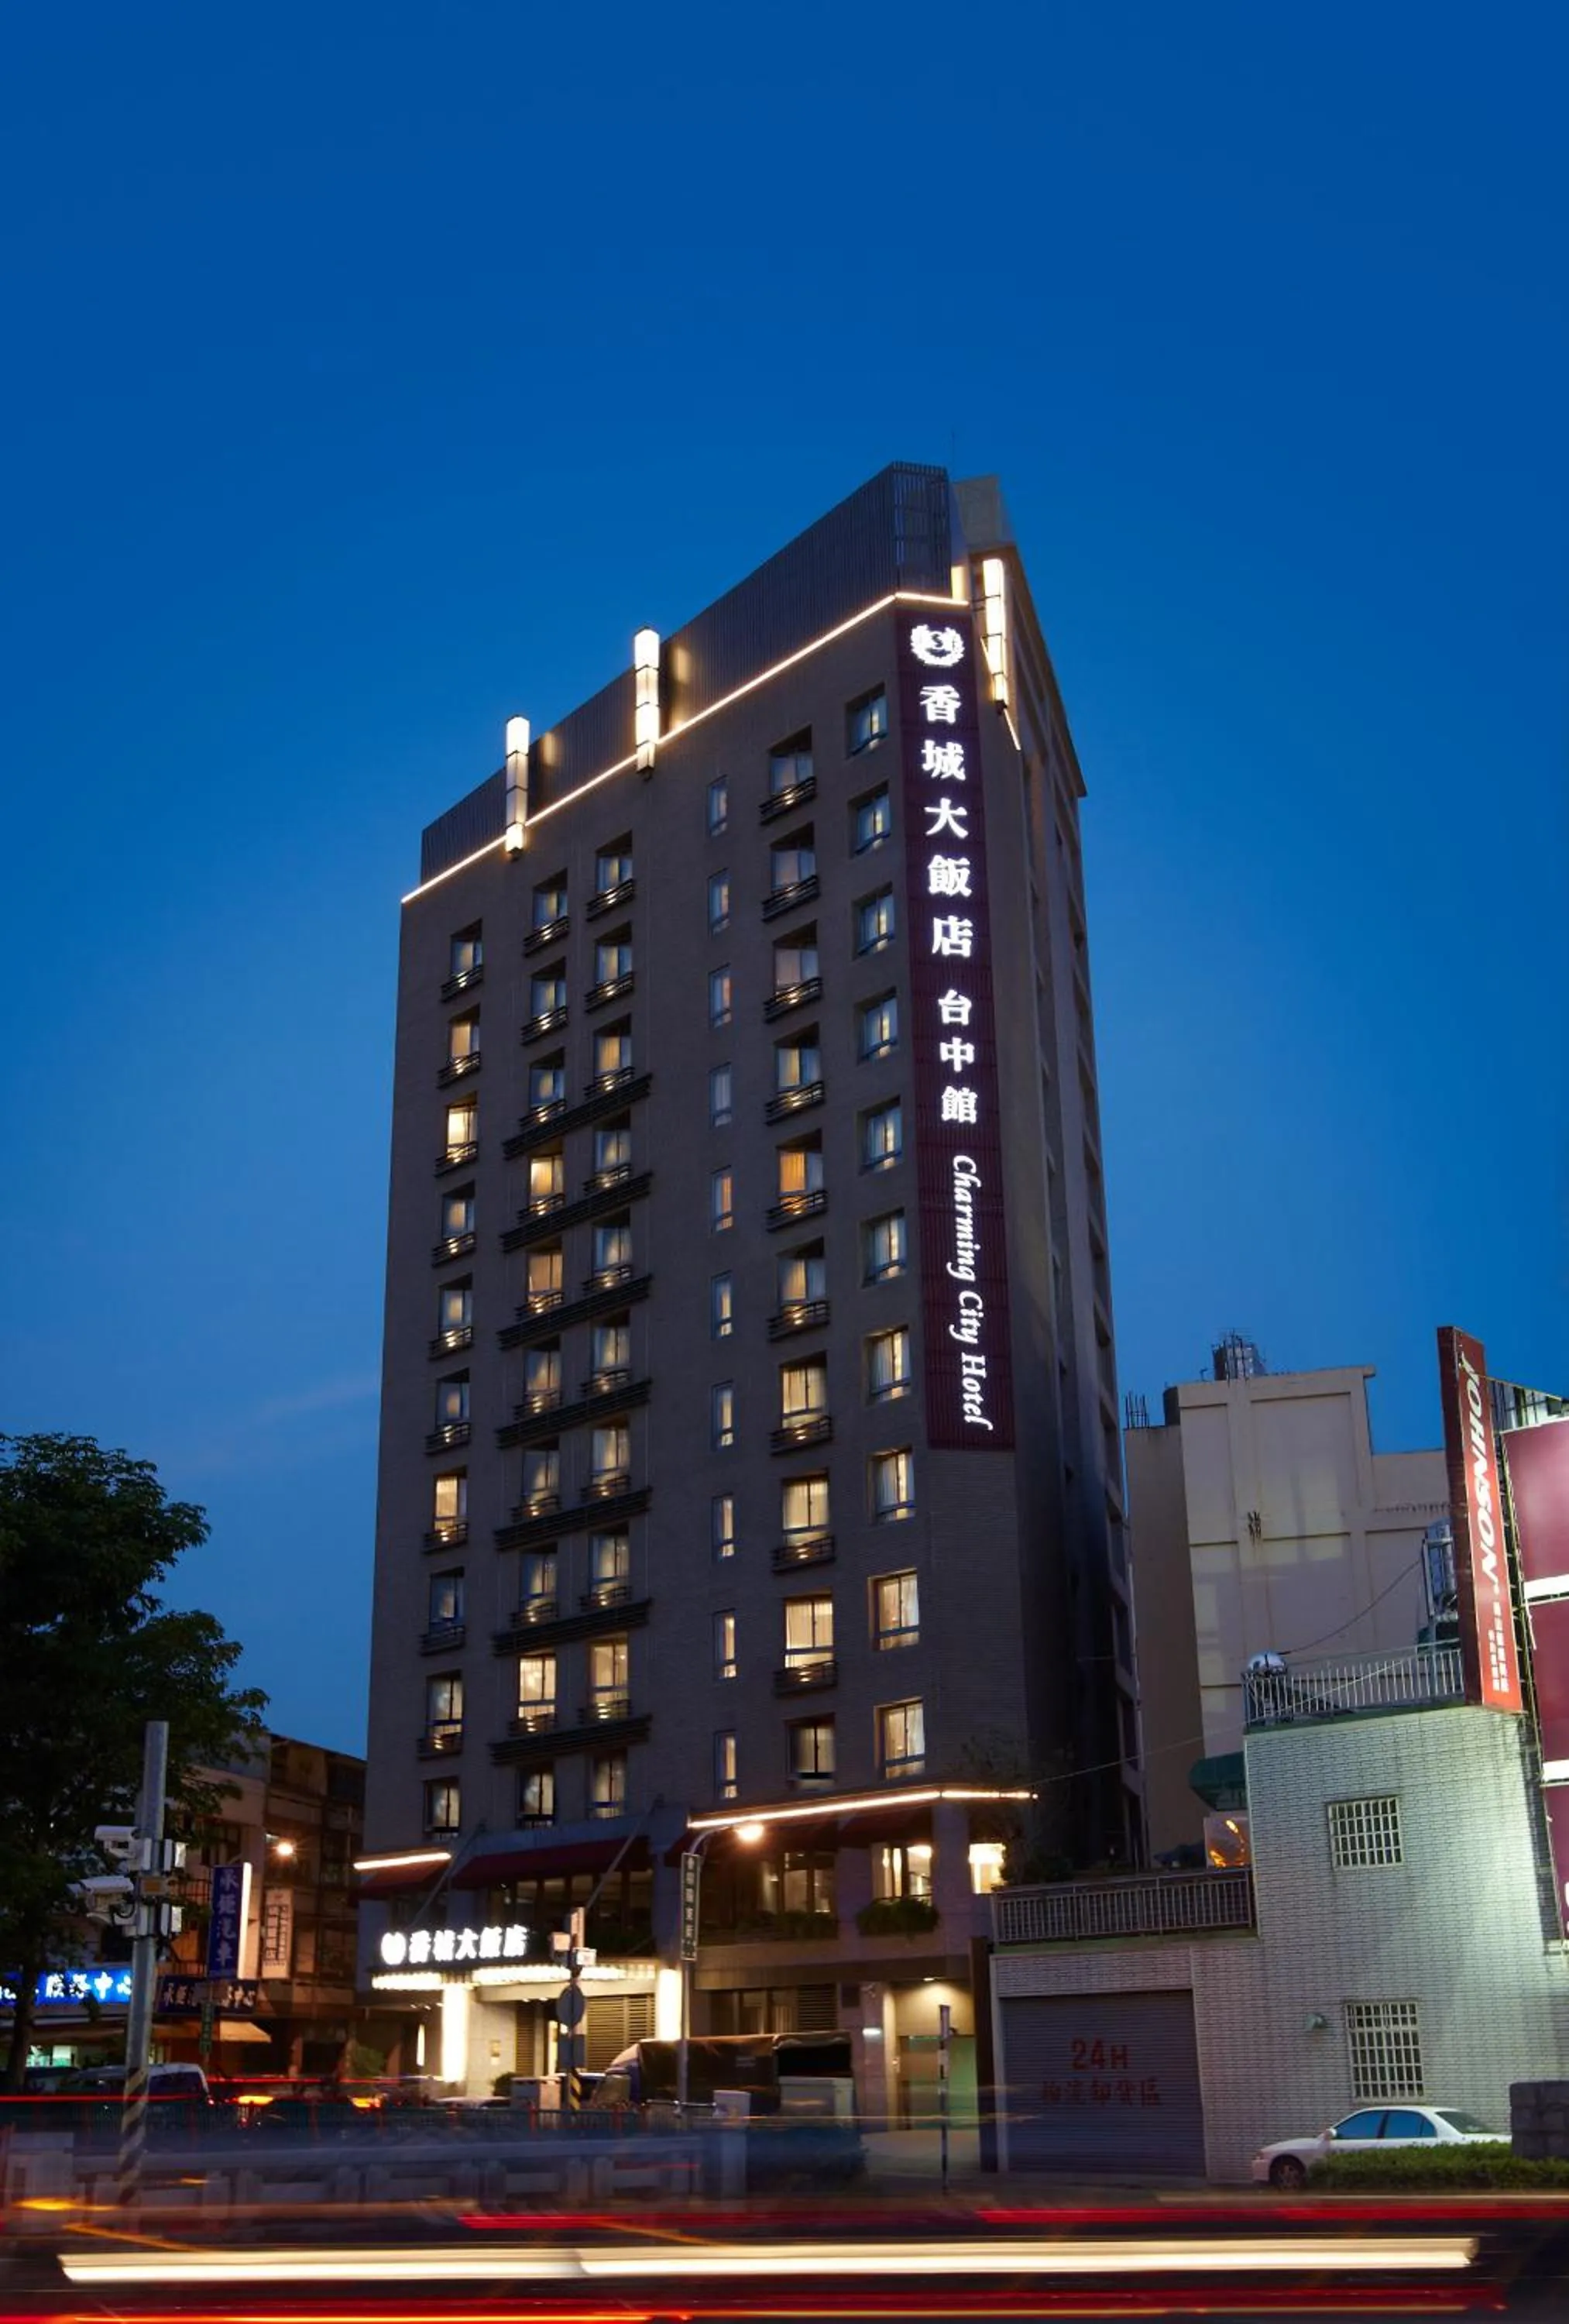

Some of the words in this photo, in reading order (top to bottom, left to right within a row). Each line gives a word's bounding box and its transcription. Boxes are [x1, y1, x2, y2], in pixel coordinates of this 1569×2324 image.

[919, 684, 973, 957] 香城大飯店
[937, 988, 978, 1124] 台中館
[946, 1155, 982, 1282] Charming
[949, 1290, 984, 1346] City
[960, 1351, 994, 1431] Hotel
[1460, 1351, 1500, 1596] JOHNSON
[1070, 2038, 1128, 2070] 24H
